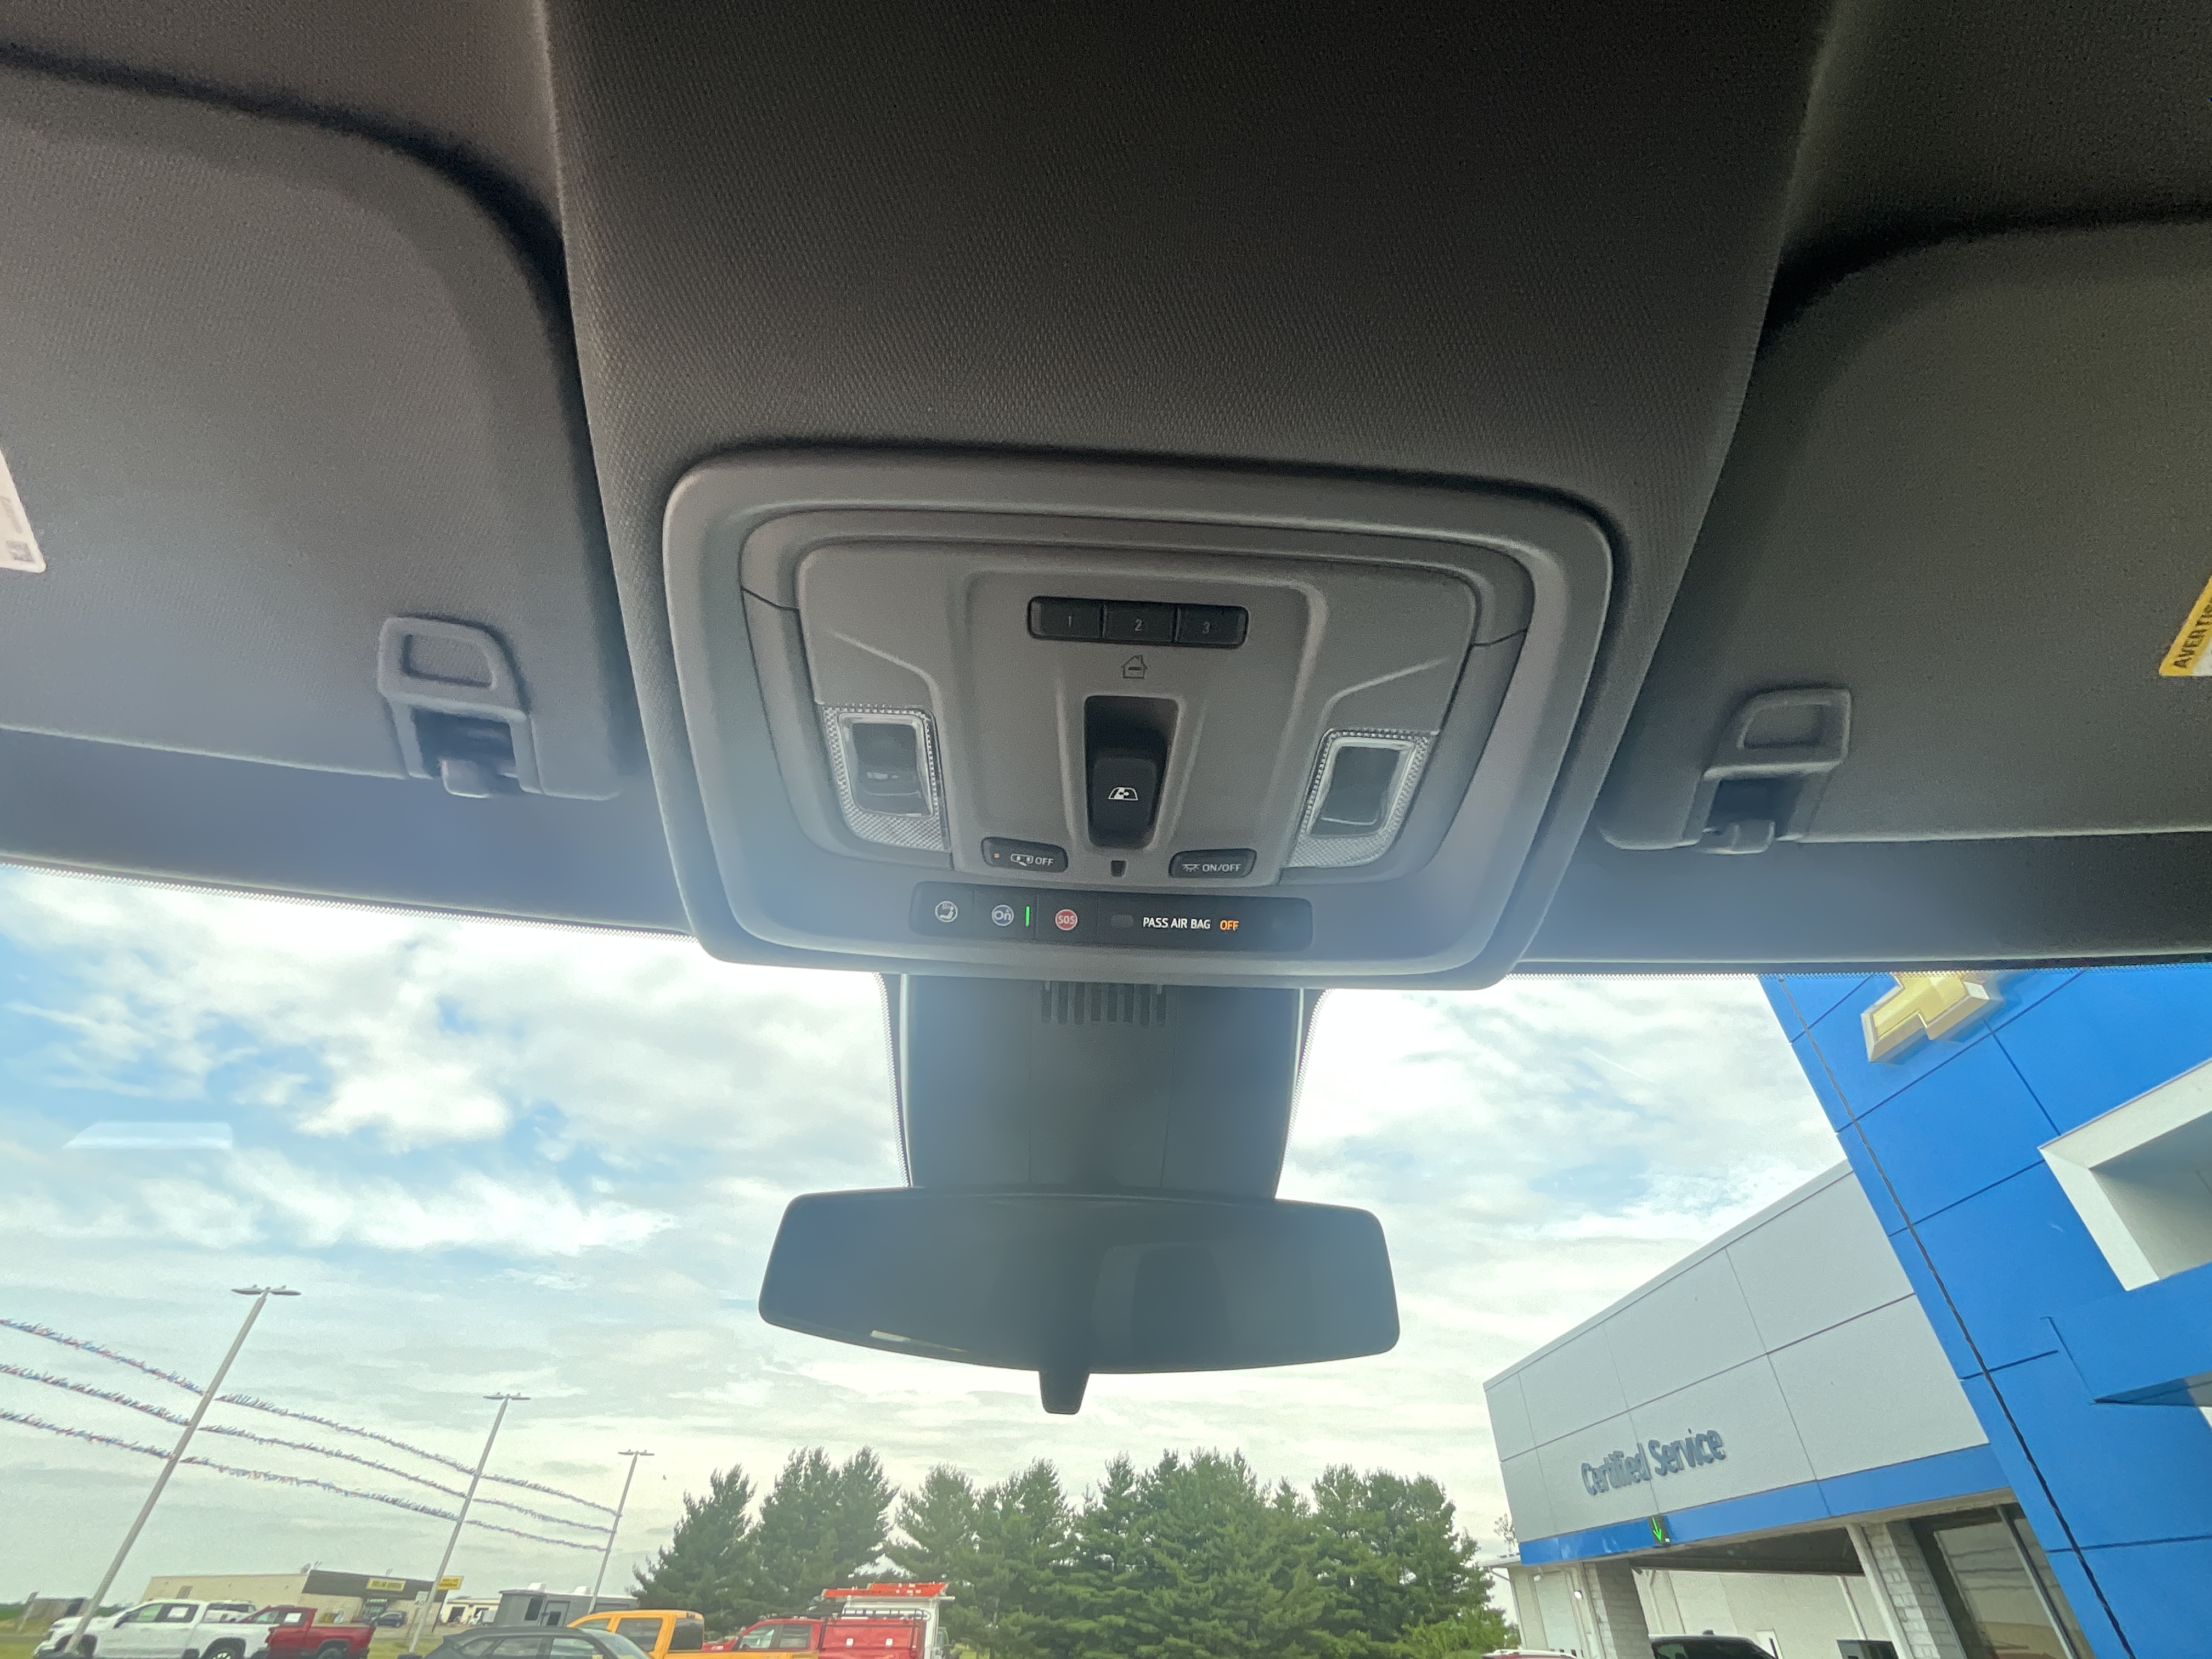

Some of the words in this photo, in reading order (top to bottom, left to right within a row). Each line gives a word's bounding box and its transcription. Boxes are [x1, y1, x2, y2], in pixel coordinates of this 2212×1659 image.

[1068, 616, 1072, 627] 1
[1135, 619, 1142, 631] 2
[1203, 621, 1210, 634] 3
[1035, 857, 1054, 866] OFF
[1202, 864, 1242, 872] ON/OFF
[1058, 915, 1075, 924] SOS
[1143, 917, 1169, 928] PASS
[1170, 918, 1188, 929] AIR
[1190, 919, 1211, 929] BAG
[1220, 920, 1239, 931] OFF
[1581, 1443, 1652, 1496] Certified
[1648, 1430, 1726, 1476] Service
